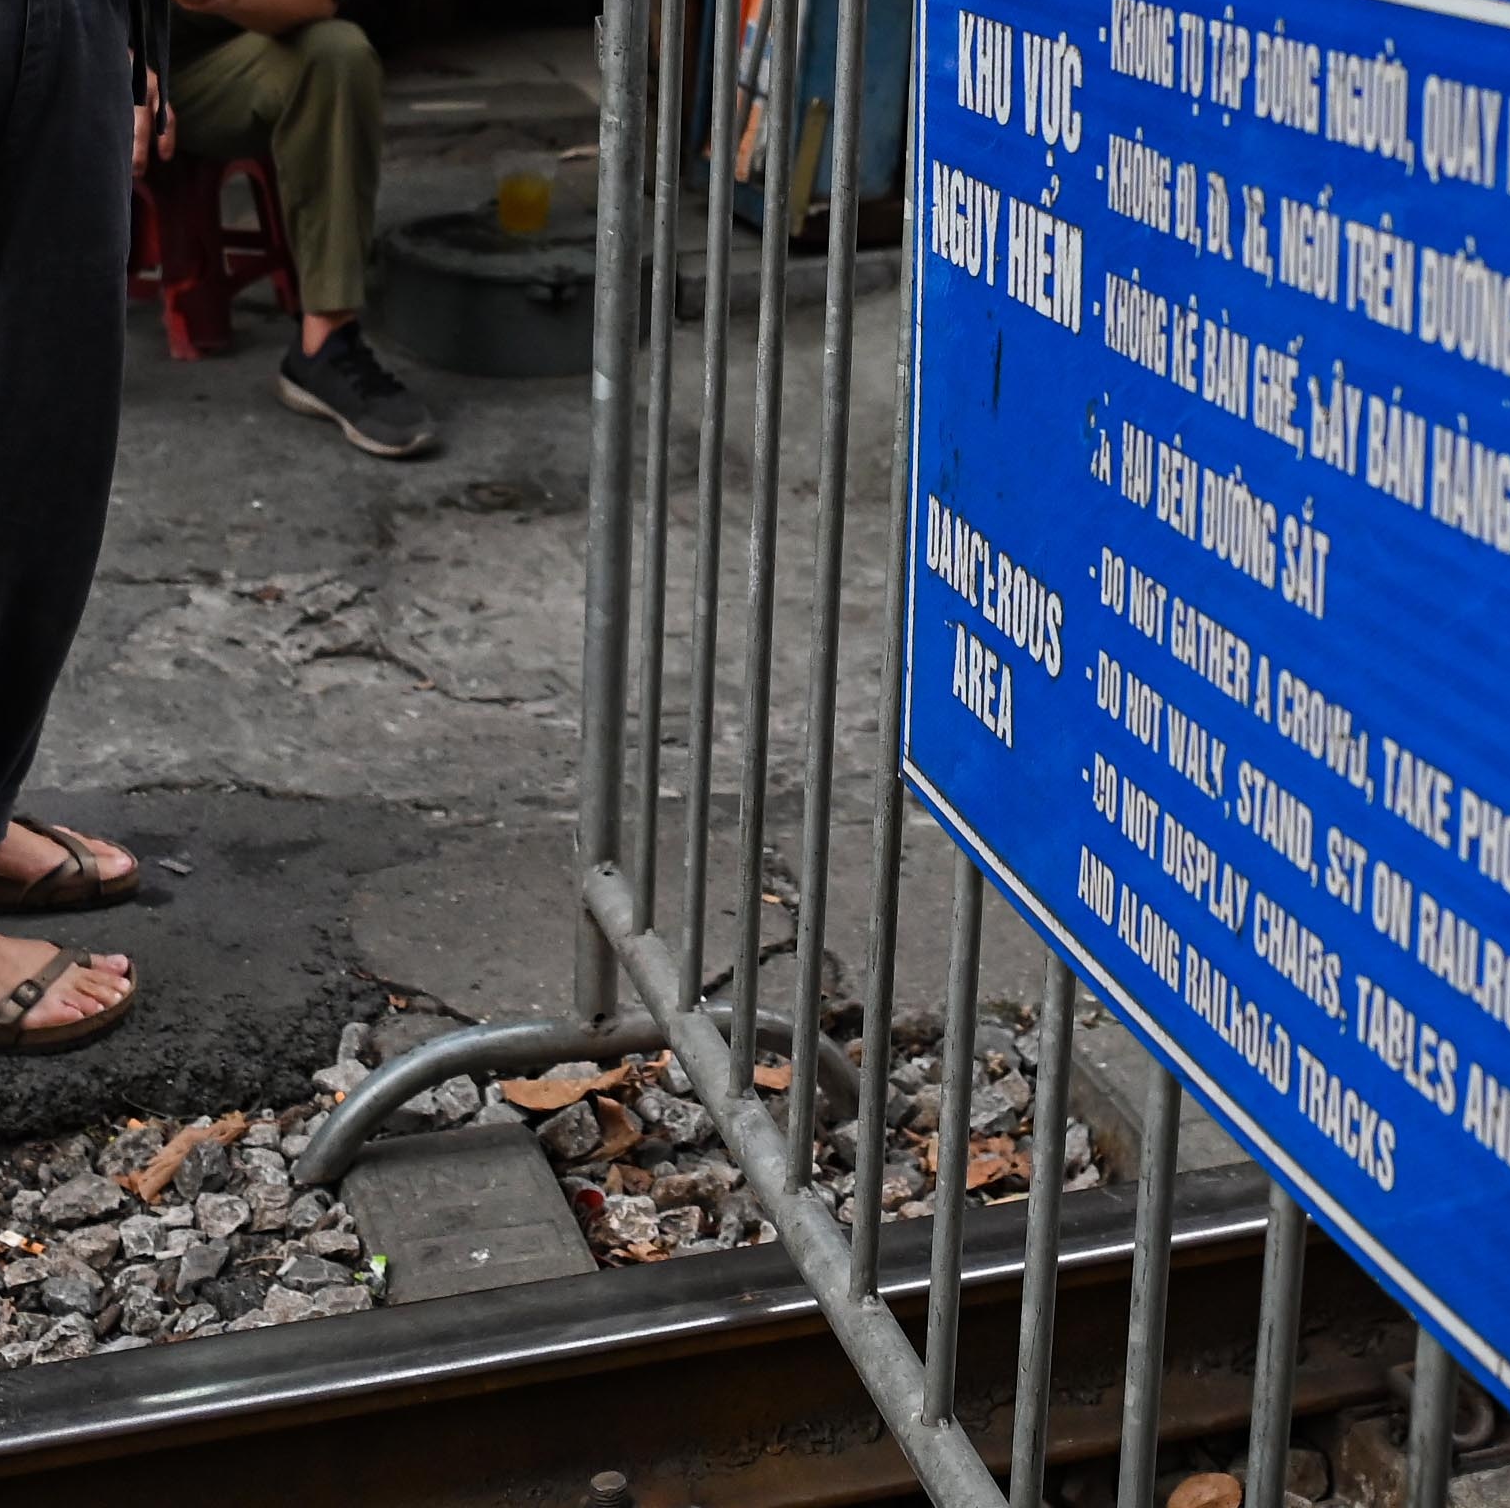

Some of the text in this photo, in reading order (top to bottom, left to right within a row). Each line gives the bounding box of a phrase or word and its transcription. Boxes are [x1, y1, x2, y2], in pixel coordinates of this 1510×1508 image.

[958, 9, 1082, 167] KHU VỰC
[1180, 11, 1205, 117] TỤ
[1209, 4, 1251, 127] TẬP
[1254, 17, 1320, 135] ĐÔNG
[1420, 73, 1502, 184] QUAY
[932, 159, 1083, 335] NGUY HIỂM
[1107, 126, 1172, 235] KHÔNG
[1279, 184, 1340, 304] NGỒI
[1344, 212, 1415, 335] TRÊN
[1103, 267, 1169, 378] KHÔNG
[1171, 293, 1200, 394] KÊ
[1202, 308, 1250, 421] BÀN
[1365, 385, 1427, 511] BÁN
[1120, 420, 1154, 509] HAI
[1157, 433, 1199, 542] BÊN
[1201, 464, 1278, 591] ĐƯỜNG
[1281, 495, 1332, 621] SẮT
[951, 621, 1015, 750] AREA
[1100, 545, 1126, 616] DO
[1129, 564, 1169, 647] NOT
[1170, 595, 1252, 708] GATHER
[1253, 653, 1272, 725] A
[1381, 735, 1455, 851] TAKE
[1095, 649, 1122, 722] DO
[1124, 671, 1165, 754] NOT
[1235, 758, 1319, 889] STAND,
[1371, 859, 1414, 952] ON
[1077, 843, 1116, 927] AND
[1117, 882, 1181, 993] ALONG
[1296, 1042, 1397, 1193] TRACKS
[1092, 751, 1119, 825] DO
[1121, 776, 1160, 861] NOT
[1162, 811, 1251, 934] DISPLAY
[1355, 973, 1459, 1117] TABLES
